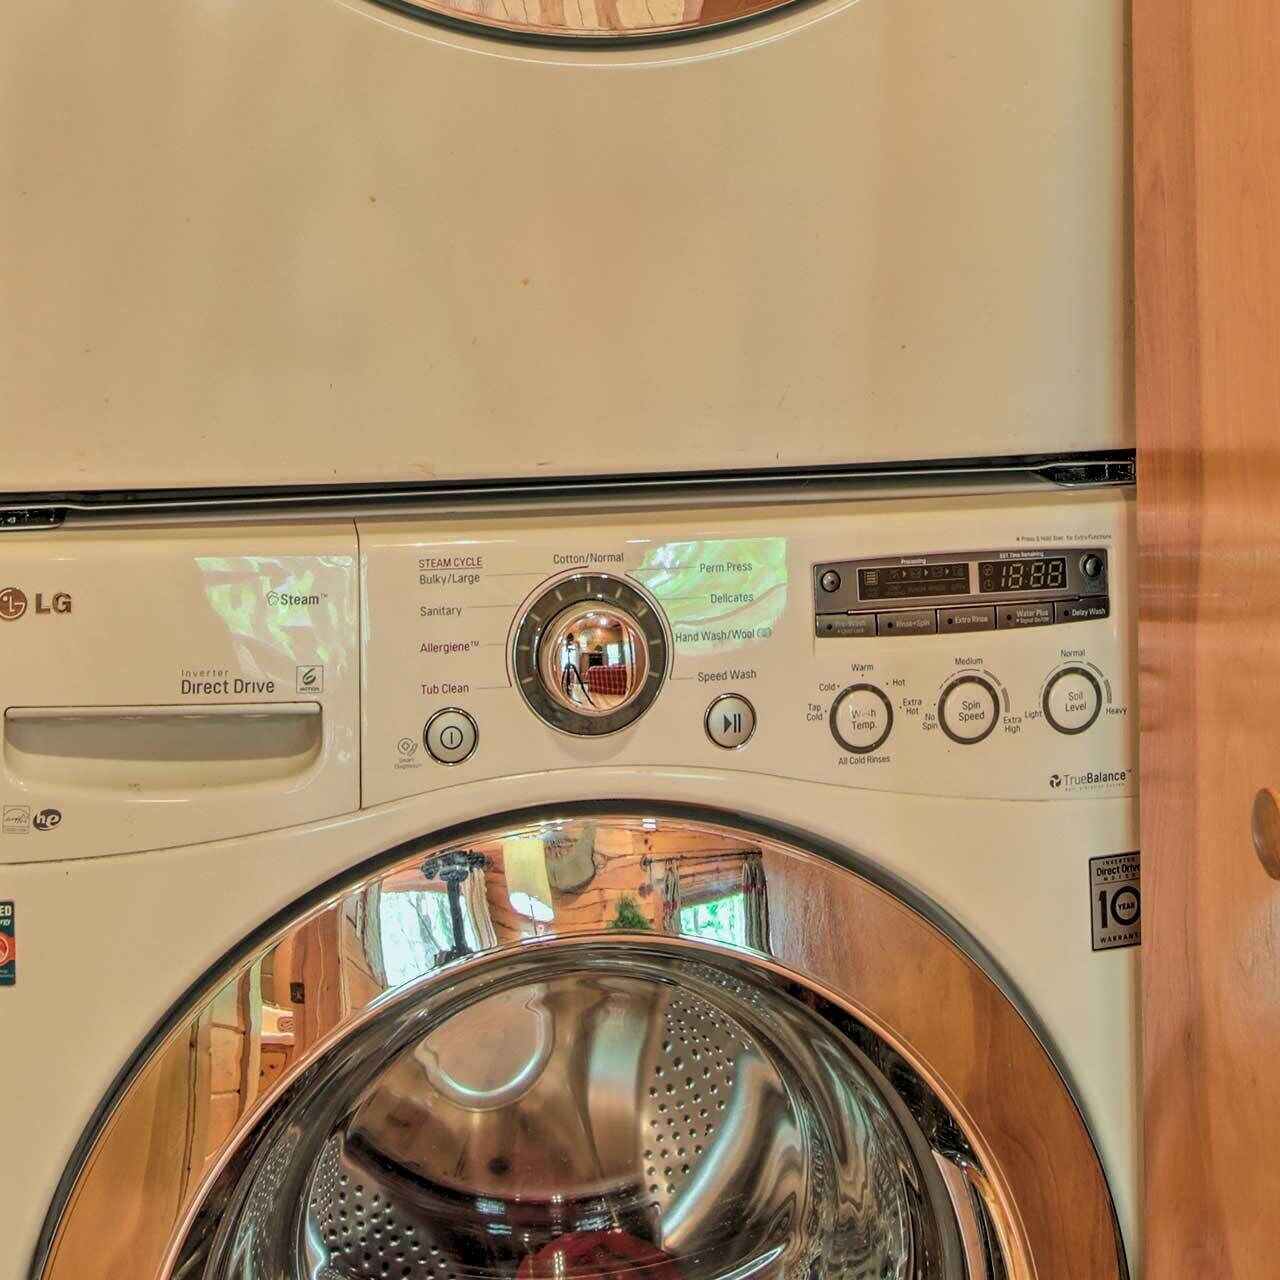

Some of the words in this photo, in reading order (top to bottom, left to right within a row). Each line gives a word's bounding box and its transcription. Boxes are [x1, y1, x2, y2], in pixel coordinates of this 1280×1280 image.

[419, 558, 451, 568] STEAM
[453, 556, 482, 567] CYCLE
[553, 552, 624, 564] Cotton/Normal
[727, 561, 753, 571] Press
[420, 574, 480, 585] Bulky/Large
[35, 592, 72, 614] LG
[710, 593, 754, 604] Delicates
[420, 606, 462, 617] Sanitary
[1072, 609, 1089, 617] Delay
[1090, 607, 1106, 615] Wash
[955, 616, 972, 624] Extra
[675, 633, 699, 642] Hand
[701, 629, 755, 641] Wash/Wool
[1060, 649, 1086, 657] Normal
[181, 669, 229, 677] Inverter
[698, 671, 728, 683] Speed
[730, 669, 757, 680] Wash
[181, 680, 229, 694] Direct
[234, 679, 275, 693] Drive
[421, 684, 439, 695] Tub
[442, 683, 469, 694] Clean
[819, 683, 836, 691] Cold
[1068, 692, 1083, 701] Soil
[902, 698, 922, 706] Extra
[962, 701, 980, 711] Spin
[1065, 702, 1087, 712] Level
[808, 703, 821, 712] Tap
[906, 707, 919, 715] Hot
[1106, 707, 1127, 715] Heavy
[806, 713, 823, 721] Cold
[925, 713, 935, 721] No
[958, 711, 985, 723] Speed
[1024, 710, 1042, 719] Light
[1003, 716, 1022, 724] Extra
[851, 721, 877, 731] Temp.
[922, 722, 938, 731] Spin
[1005, 725, 1020, 734] High
[838, 757, 848, 765] All
[849, 756, 866, 765] Cold
[867, 755, 891, 764] Rinses
[33, 808, 62, 831] he
[1097, 867, 1120, 876] Direct
[1098, 886, 1141, 928] 10
[1118, 902, 1135, 910] YEAR
